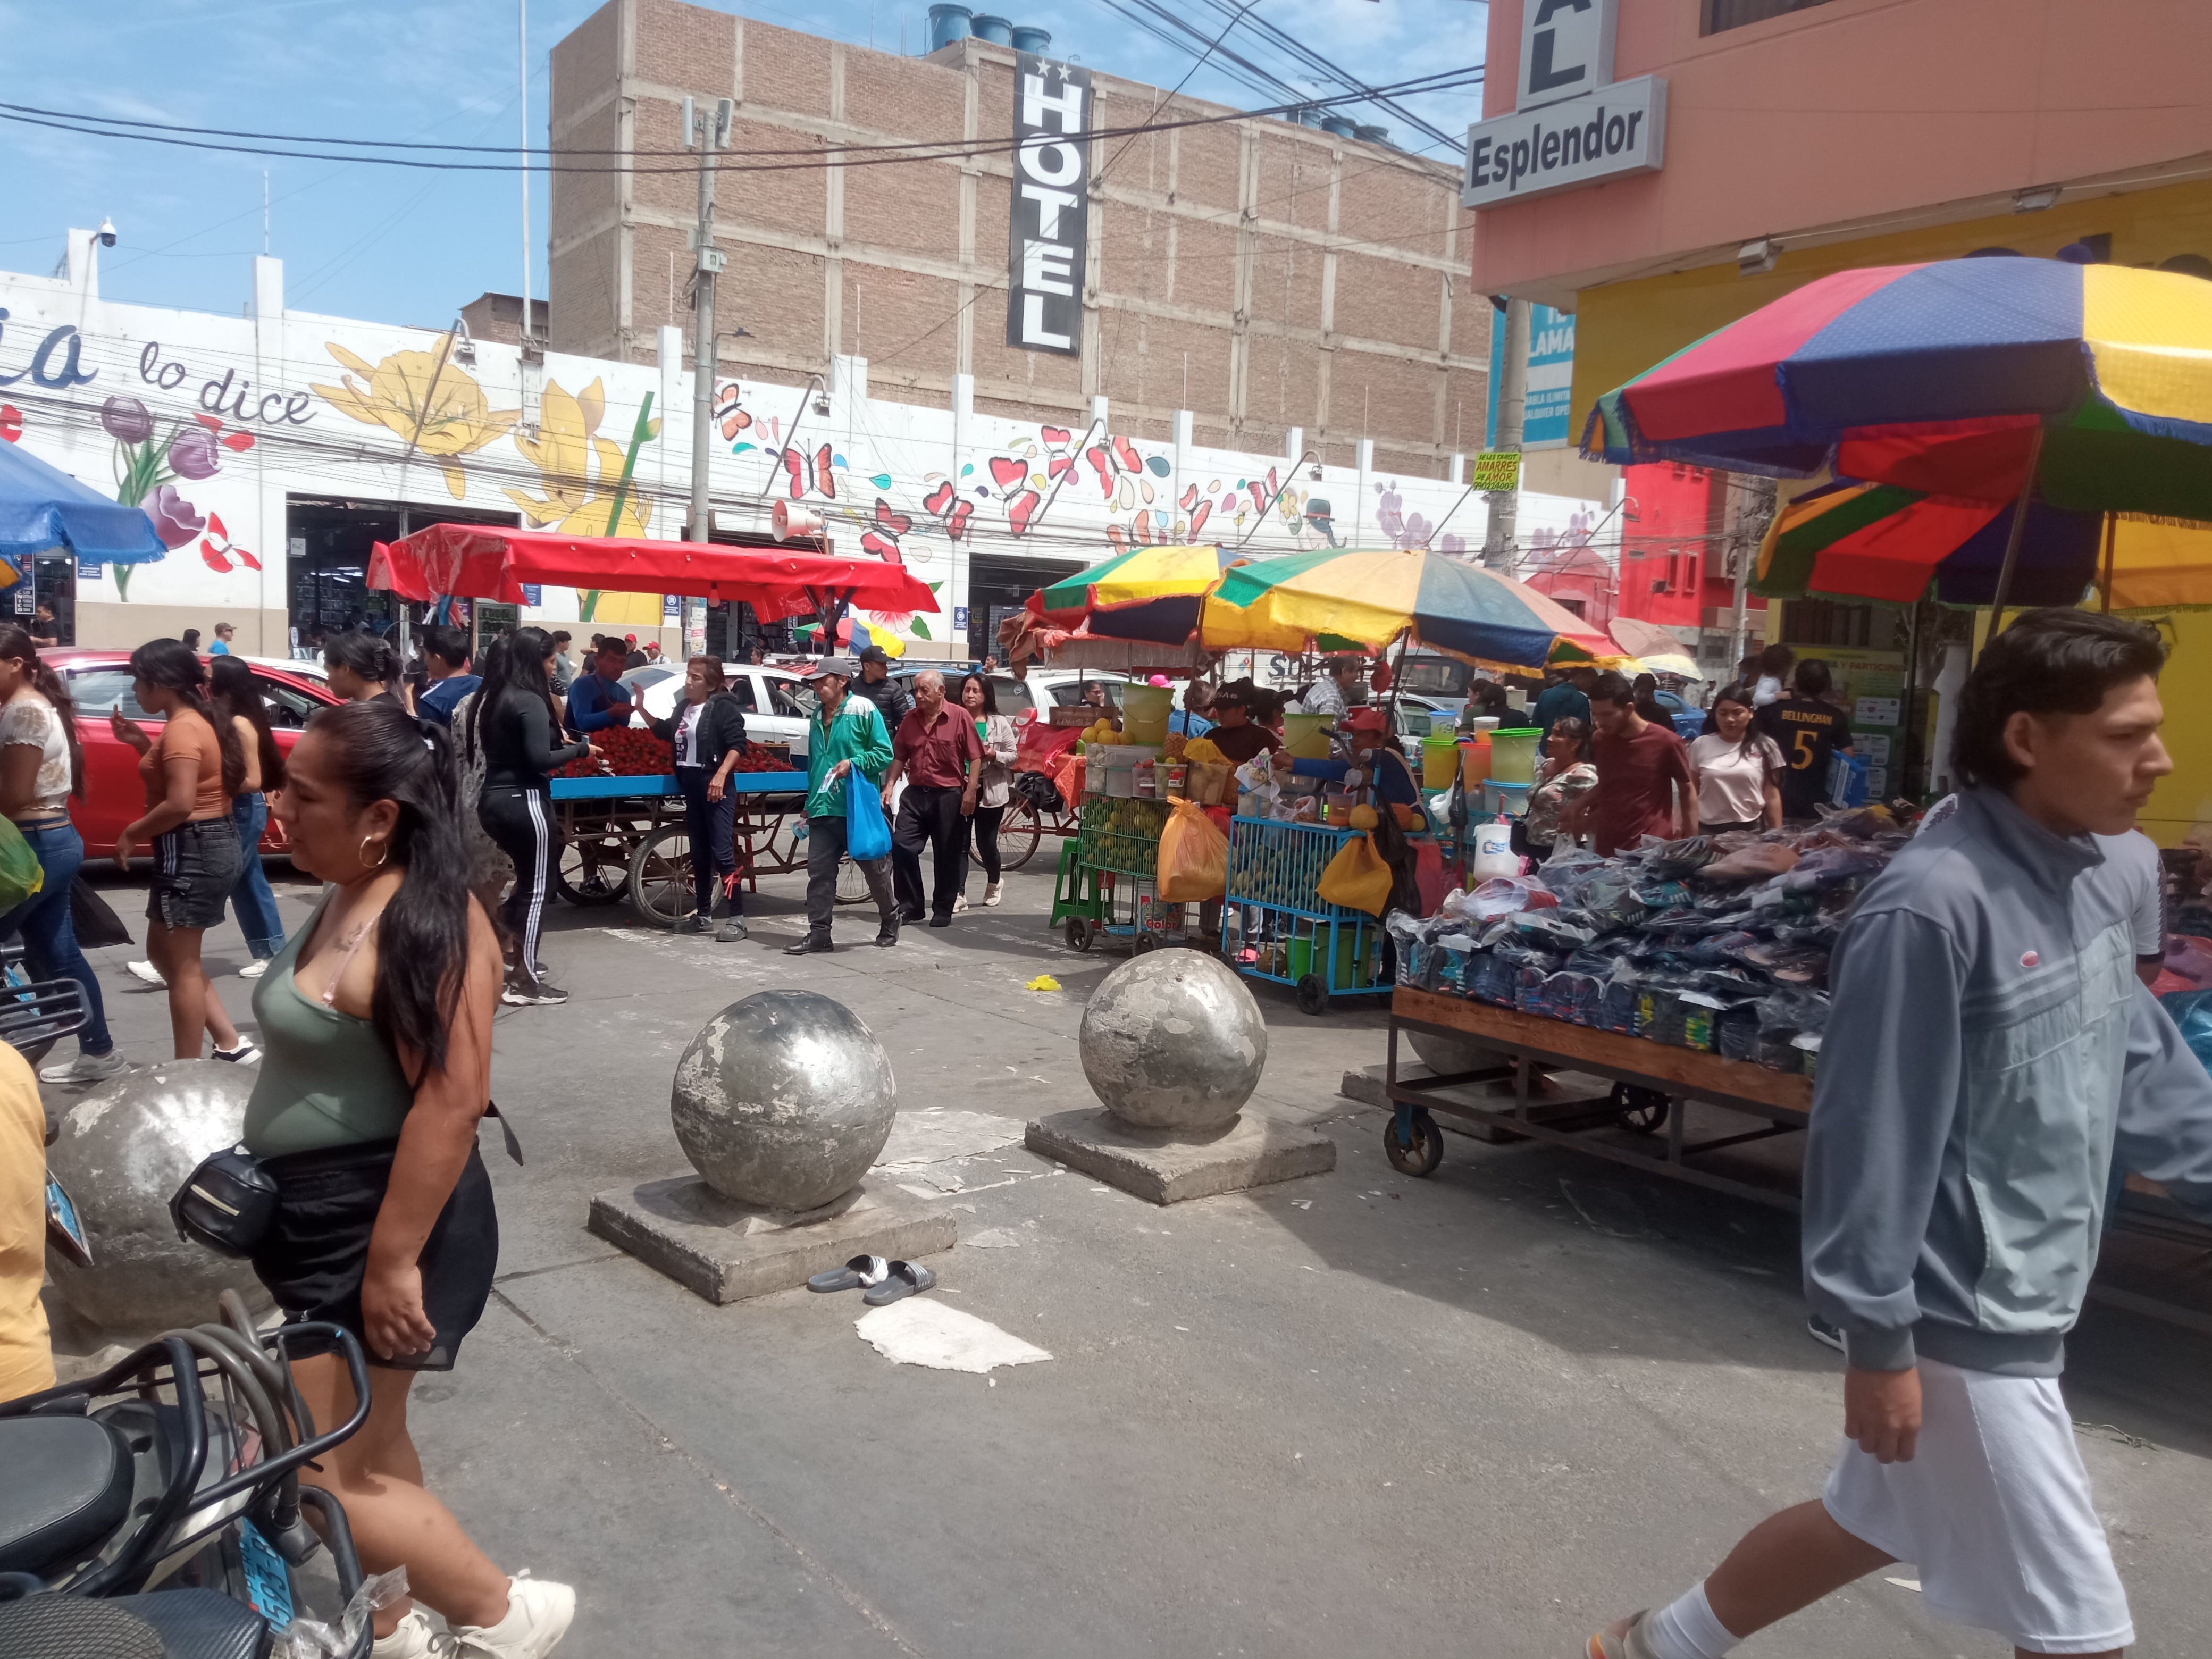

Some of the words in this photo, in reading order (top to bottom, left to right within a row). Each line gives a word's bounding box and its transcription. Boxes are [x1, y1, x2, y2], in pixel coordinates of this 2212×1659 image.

[1471, 106, 1643, 192] Esplendor
[1019, 73, 1082, 349] HOTEL
[140, 341, 191, 390] lo
[200, 368, 318, 425] dice
[1476, 461, 1518, 472] AMARRES
[1485, 472, 1512, 482] AMOR
[1473, 481, 1515, 491] 990224003
[1781, 710, 1832, 725] BELLINGHAM
[1791, 730, 1817, 770] 5
